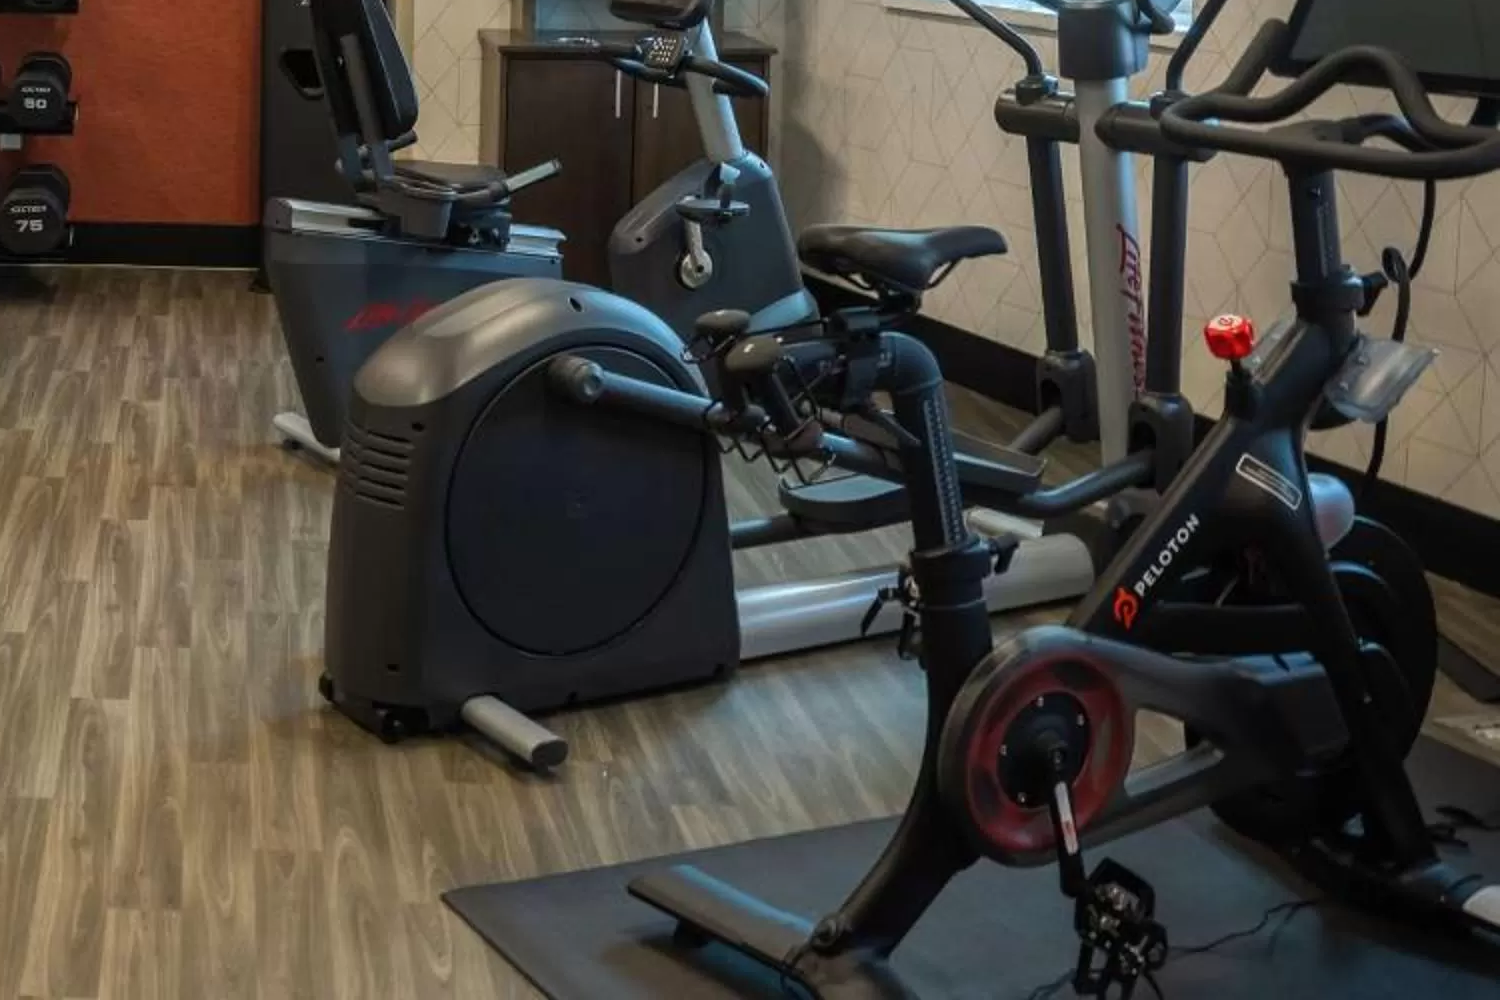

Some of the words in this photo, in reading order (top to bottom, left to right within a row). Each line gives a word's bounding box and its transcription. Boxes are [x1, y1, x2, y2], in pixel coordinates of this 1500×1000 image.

[24, 98, 47, 110] 50
[15, 219, 44, 232] 75
[1133, 513, 1200, 597] PELOTON
